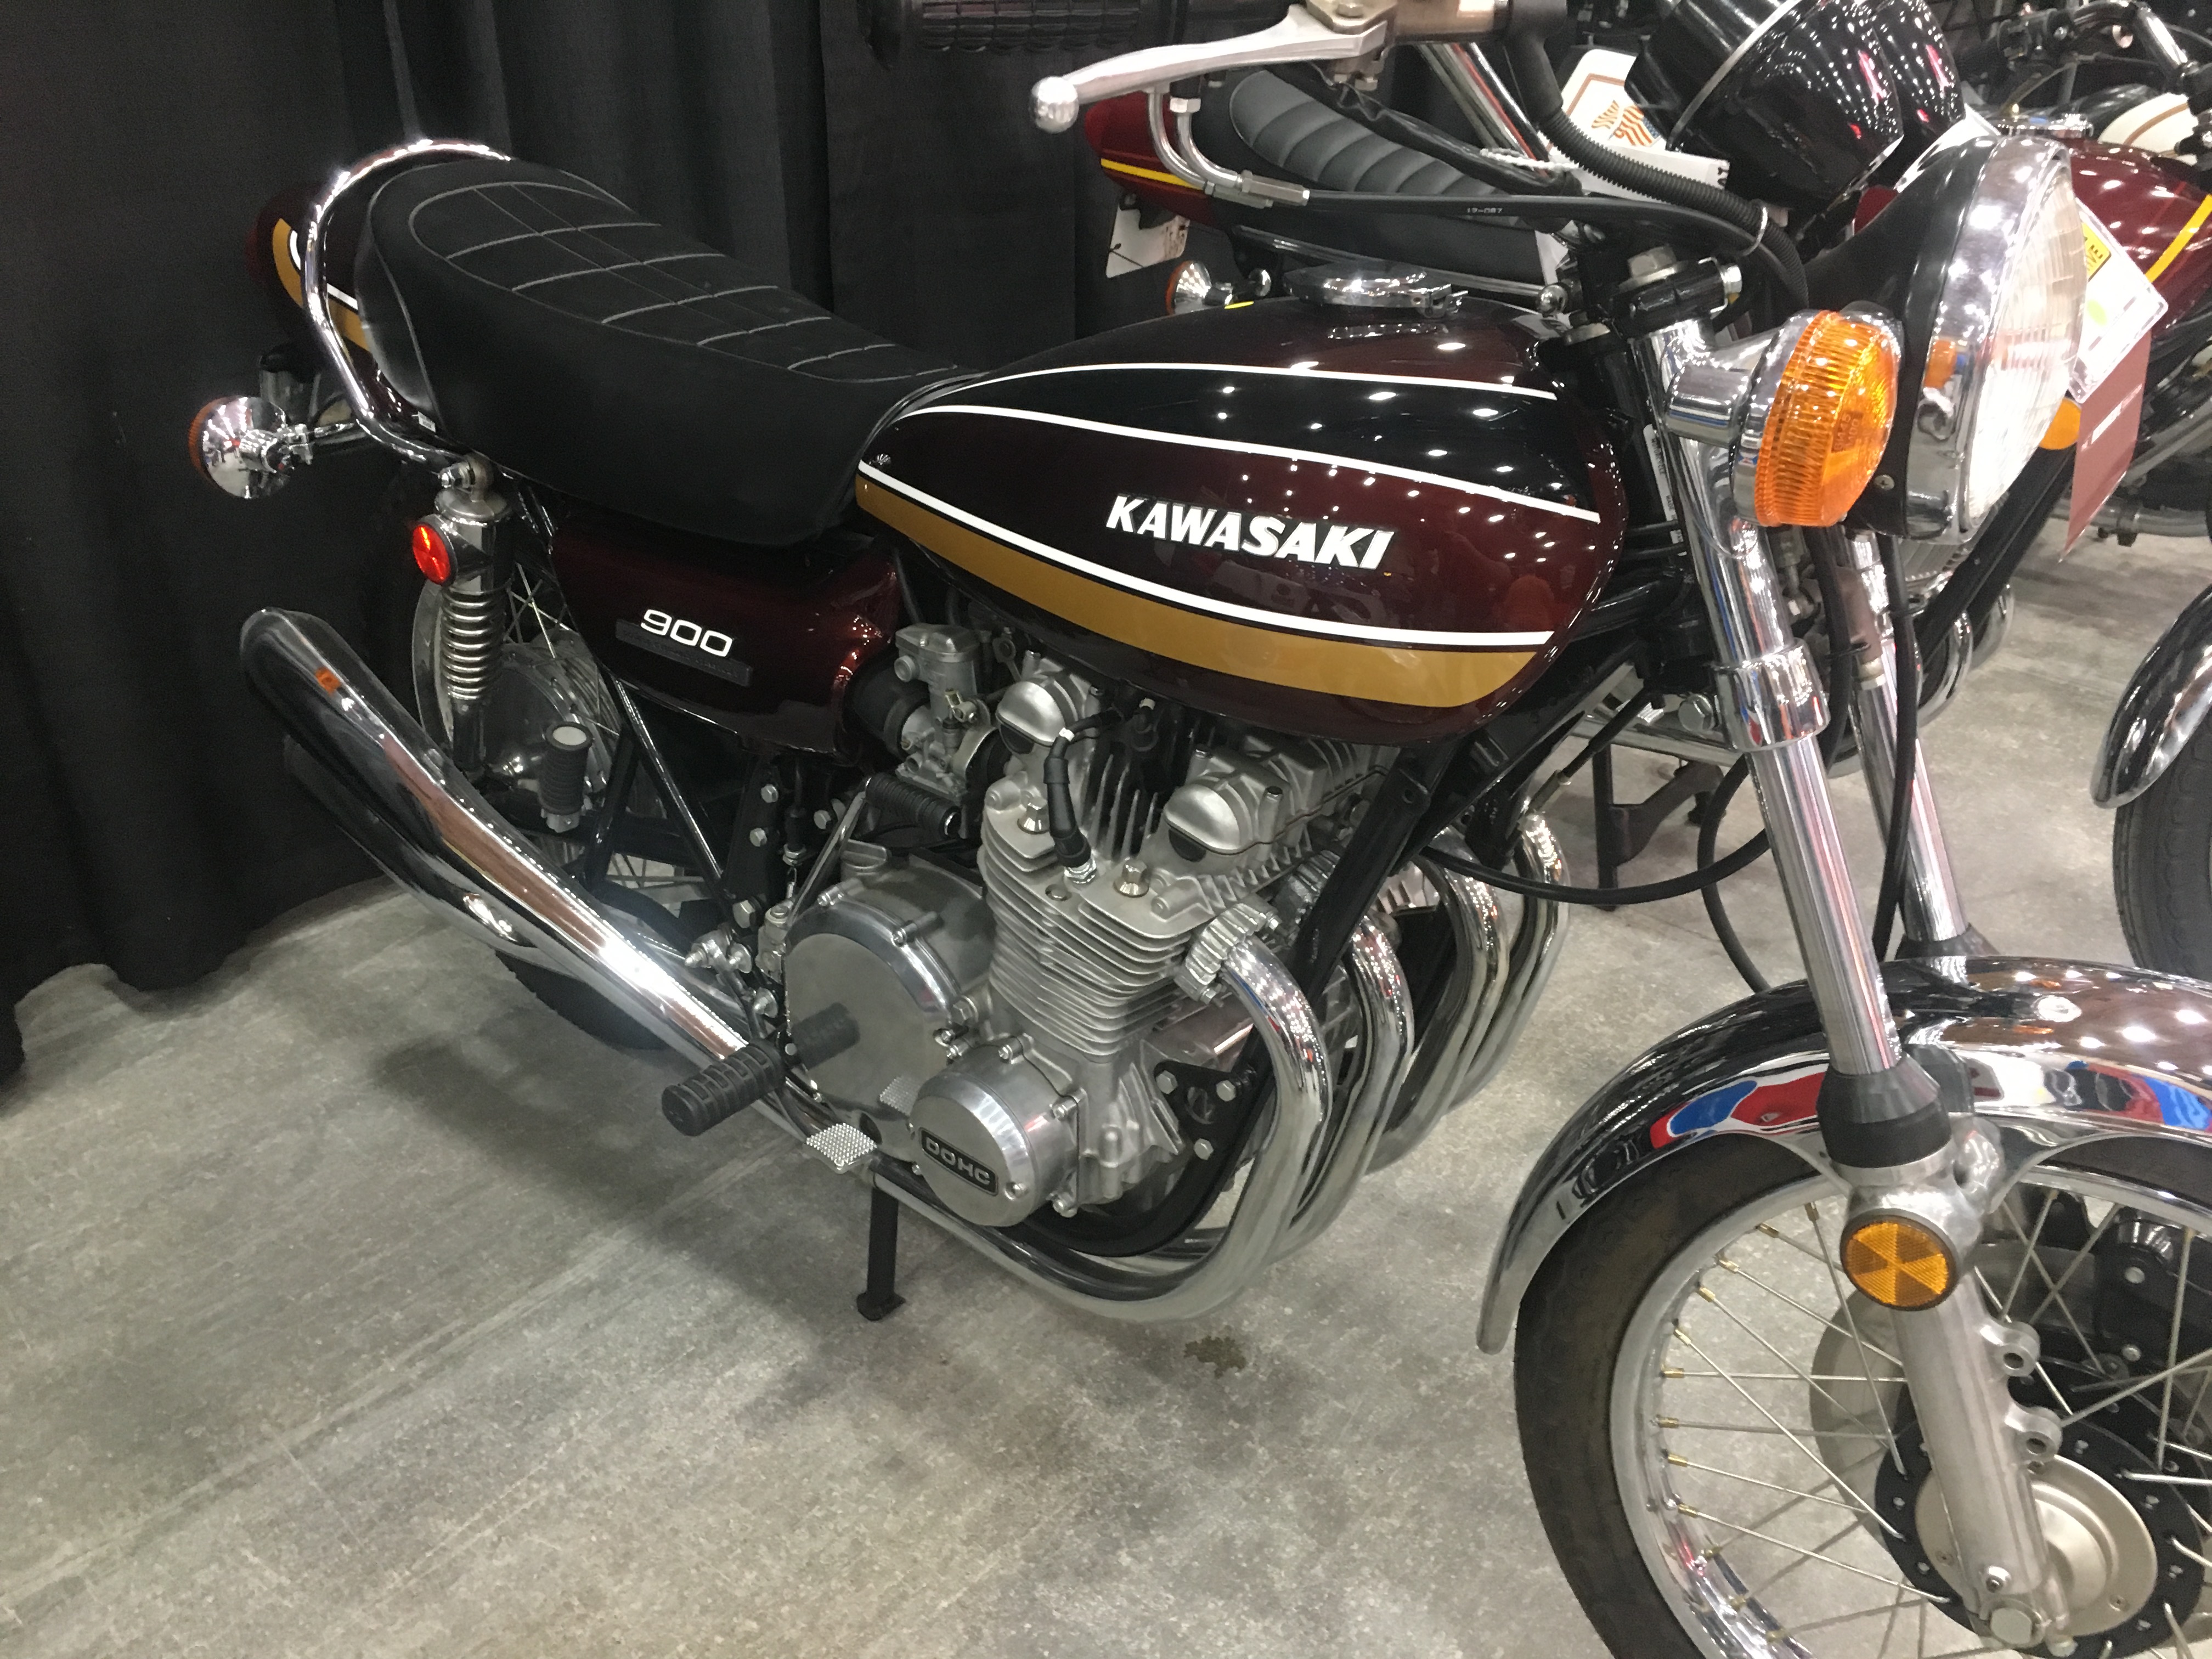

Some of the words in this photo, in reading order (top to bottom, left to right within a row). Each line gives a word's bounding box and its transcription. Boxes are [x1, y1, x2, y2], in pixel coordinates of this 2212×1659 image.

[1105, 493, 1396, 570] KAWASAKI
[640, 608, 733, 657] 900
[926, 1137, 991, 1185] DOHC
